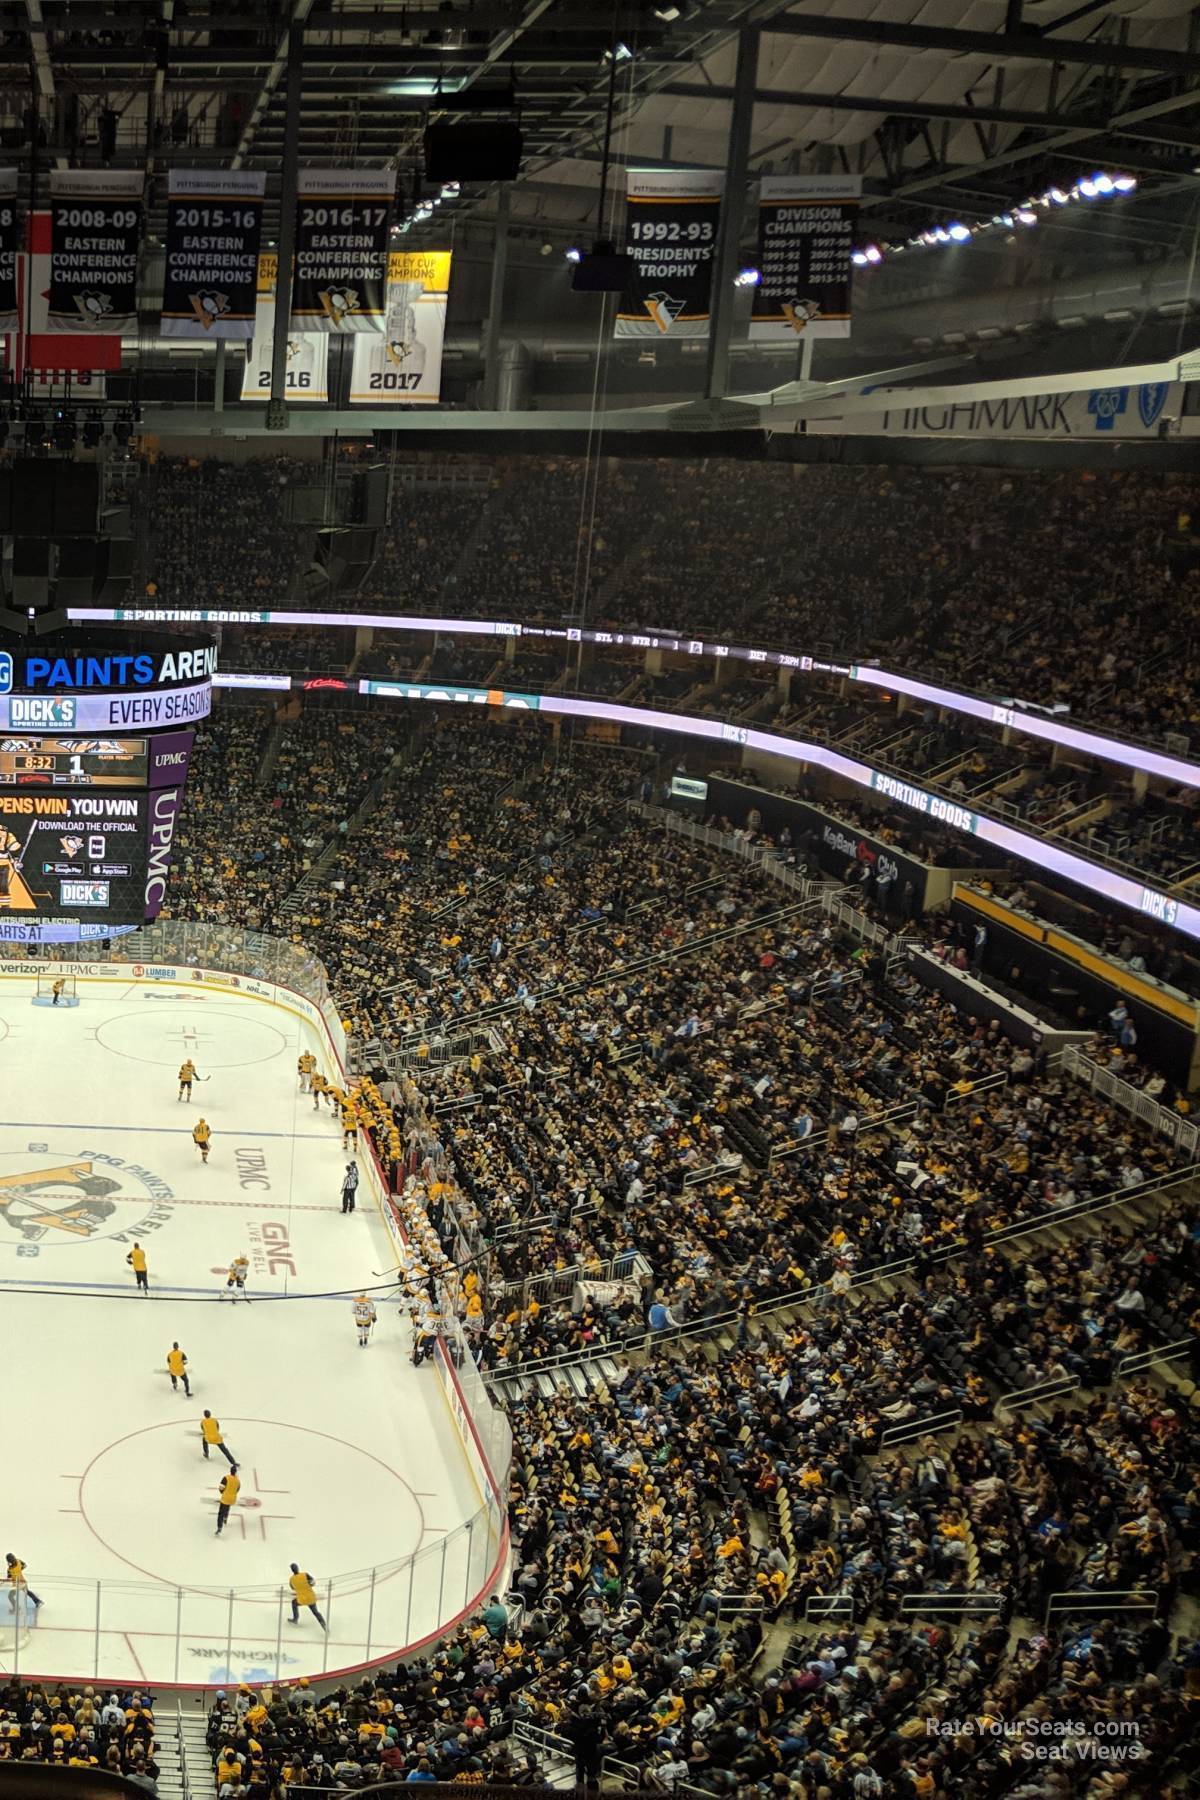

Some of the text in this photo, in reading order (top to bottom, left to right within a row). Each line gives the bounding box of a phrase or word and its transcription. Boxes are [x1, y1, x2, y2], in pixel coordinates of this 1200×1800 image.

[56, 209, 137, 228] 2008-09
[176, 208, 256, 228] 2015-16
[302, 208, 386, 226] 2016-17
[777, 208, 842, 221] DIVISION
[631, 223, 713, 240] 1992-93
[765, 221, 853, 235] CHAMPIONS
[64, 237, 126, 250] EASTERN
[183, 237, 244, 250] EASTERN
[312, 235, 374, 248] EASTERN
[52, 254, 136, 268] CONFERENCE
[170, 252, 256, 267] CONFERENCE
[297, 251, 386, 264] CONFERENCE
[417, 258, 437, 268] CUP
[299, 267, 383, 280] CHAMPIONS
[640, 264, 698, 277] TROPHY
[809, 263, 848, 272] 2012-13
[54, 270, 134, 284] CHAMPIONS
[170, 269, 252, 284] CHAMPIONS
[808, 275, 848, 284] 2013-14
[258, 371, 311, 388] 216
[370, 372, 423, 390] 2017
[124, 610, 262, 624] SPORTING GOODS
[595, 633, 612, 642] STL
[749, 650, 768, 660] DET
[26, 656, 154, 687] PAINTS
[158, 646, 218, 682] ARENA
[12, 700, 74, 722] DICK'S
[110, 698, 162, 724] EVERY
[166, 690, 206, 719] SEASON
[722, 723, 748, 744] DICK'S
[25, 757, 52, 768] 8:32
[70, 756, 84, 774] 1
[155, 752, 186, 767] UPMC
[35, 798, 72, 817] WIN,
[72, 799, 104, 816] YOU
[105, 800, 138, 816] WIN
[874, 774, 972, 832] SPORTING GOODS
[38, 821, 138, 832] DOWNLOAD THE OFFICIAL
[144, 790, 178, 905] UPMC
[823, 825, 899, 882] KeyBank Club
[63, 884, 108, 901] DICK'S
[1142, 890, 1178, 924] DICK'S
[29, 927, 44, 940] AT
[80, 924, 108, 937] DICK'S
[0, 963, 46, 974] verizon
[59, 965, 98, 976] UPMC
[146, 968, 176, 977] LUMBER
[1159, 1118, 1174, 1136] 103
[234, 1148, 272, 1191] UPMC
[79, 1150, 174, 1243] PPG PAINTS ARENA
[246, 1222, 267, 1274] LIVE WELL
[262, 1222, 297, 1276] GNC
[356, 1306, 368, 1316] 52
[187, 1648, 287, 1664] HIGHMARK
